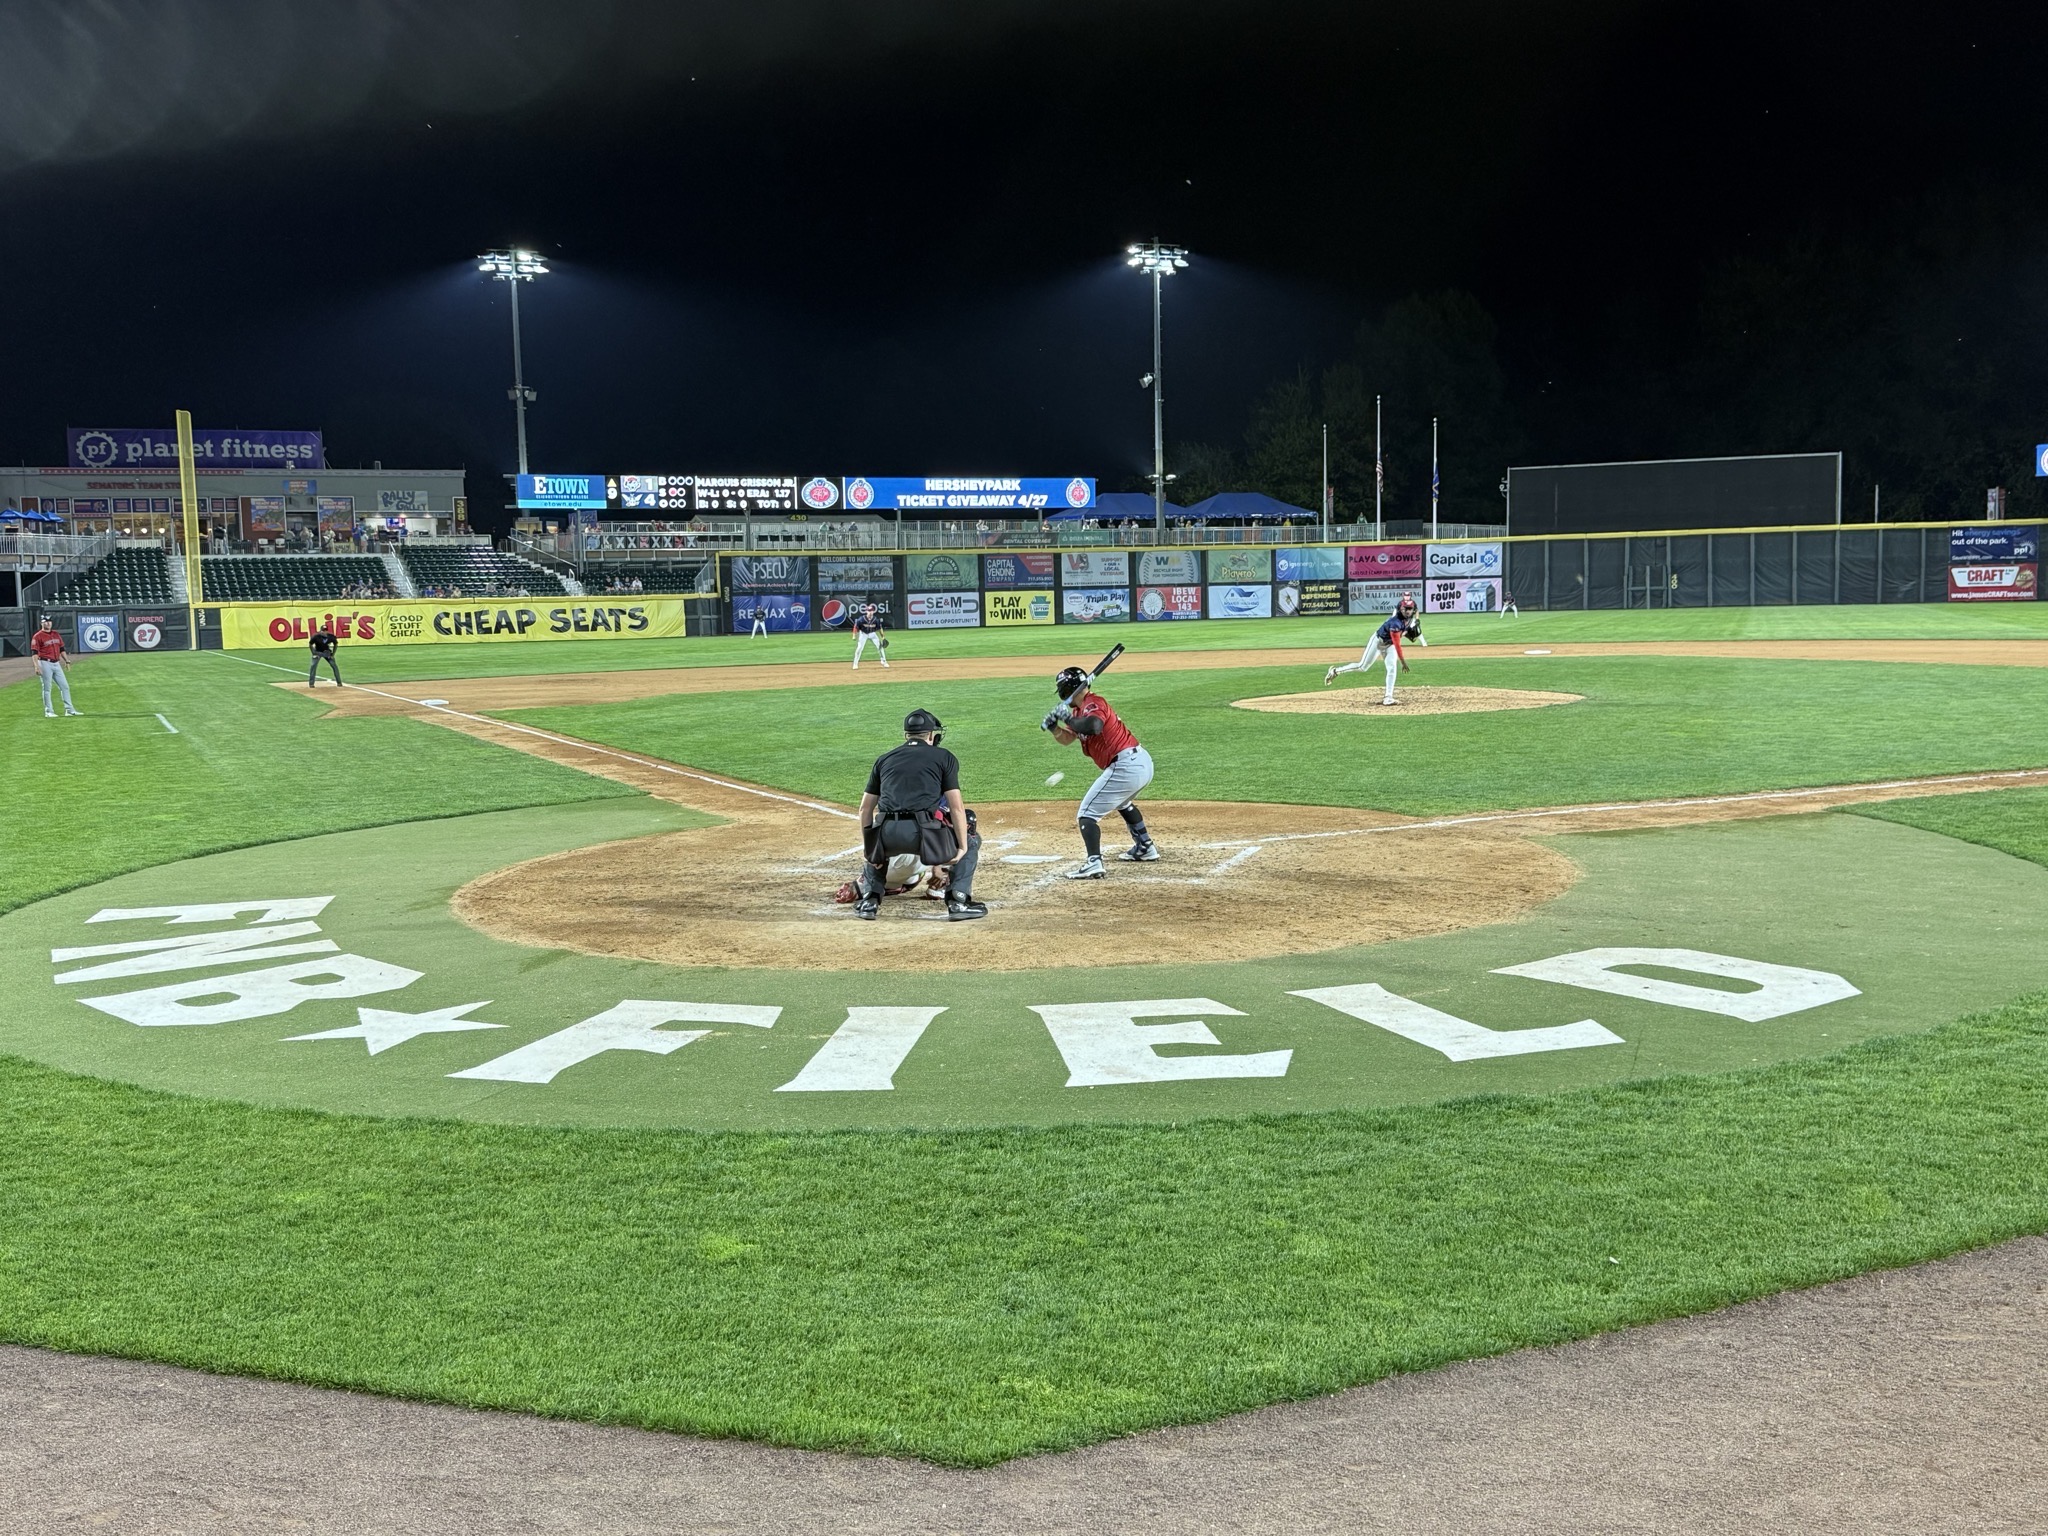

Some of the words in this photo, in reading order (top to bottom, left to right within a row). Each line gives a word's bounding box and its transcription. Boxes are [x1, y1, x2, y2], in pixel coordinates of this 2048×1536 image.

[87, 442, 107, 458] pf
[221, 439, 313, 459] fitness
[645, 478, 655, 491] 1
[658, 476, 667, 486] B
[698, 478, 740, 488] MARQUIS
[740, 478, 781, 488] GRISSOM
[925, 479, 1021, 491] HERSHEYPARK
[607, 487, 618, 500] 9
[658, 487, 667, 498] S
[722, 489, 730, 498] 0
[737, 489, 746, 498] 0
[746, 488, 770, 498] ERA:
[774, 488, 791, 498] 1.17
[382, 490, 416, 508] RALLY
[643, 493, 657, 507] 4
[897, 495, 945, 507] TICKET
[947, 494, 1016, 507] GIVEAWAY
[1017, 494, 1049, 509] 4/27
[711, 500, 719, 509] 0
[739, 500, 748, 509] 0
[757, 500, 780, 509] TOT:
[783, 500, 792, 509] 0
[1952, 529, 1963, 537] Hit
[1964, 530, 1991, 538] energy
[1991, 528, 2021, 537] savings
[1966, 537, 1975, 545] of
[1989, 537, 2009, 546] park.
[987, 559, 1015, 568] CAPITAL
[1349, 555, 1377, 563] PLAYA
[1389, 554, 1421, 562] BOWLS
[1429, 552, 1477, 567] Capital
[753, 562, 787, 579] PSECU
[987, 568, 1015, 577] VENDING
[1967, 569, 2005, 582] CRAFT
[1172, 587, 1196, 596] IBEW
[1436, 582, 1455, 592] YOU
[1086, 594, 1109, 604] Triple
[1110, 592, 1126, 602] Play
[1171, 595, 1198, 603] LOCAL
[1300, 592, 1341, 600] DEFENDERS
[1430, 591, 1462, 602] FOUND
[1951, 590, 2034, 599] www.jamesCRAFTson.com
[926, 596, 962, 609] SE&M
[993, 596, 1021, 608] PLAY
[1177, 603, 1192, 611] 143
[1439, 601, 1455, 610] US!
[1469, 601, 1484, 611] LY!
[389, 614, 423, 623] GOOD
[738, 607, 787, 620] REAX
[989, 610, 999, 618] TO
[1000, 608, 1027, 620] WIN!
[81, 616, 114, 624] ROBINSON
[128, 615, 164, 623] GUERRERO
[433, 608, 536, 636] CHEAP
[549, 607, 649, 633] SEATS
[940, 617, 978, 625] OPPORTUNITY
[389, 622, 423, 630] STUFF
[88, 630, 108, 643] 42
[137, 629, 157, 643] 27
[390, 629, 422, 638] CHEAP
[444, 946, 1862, 1094] FIELD
